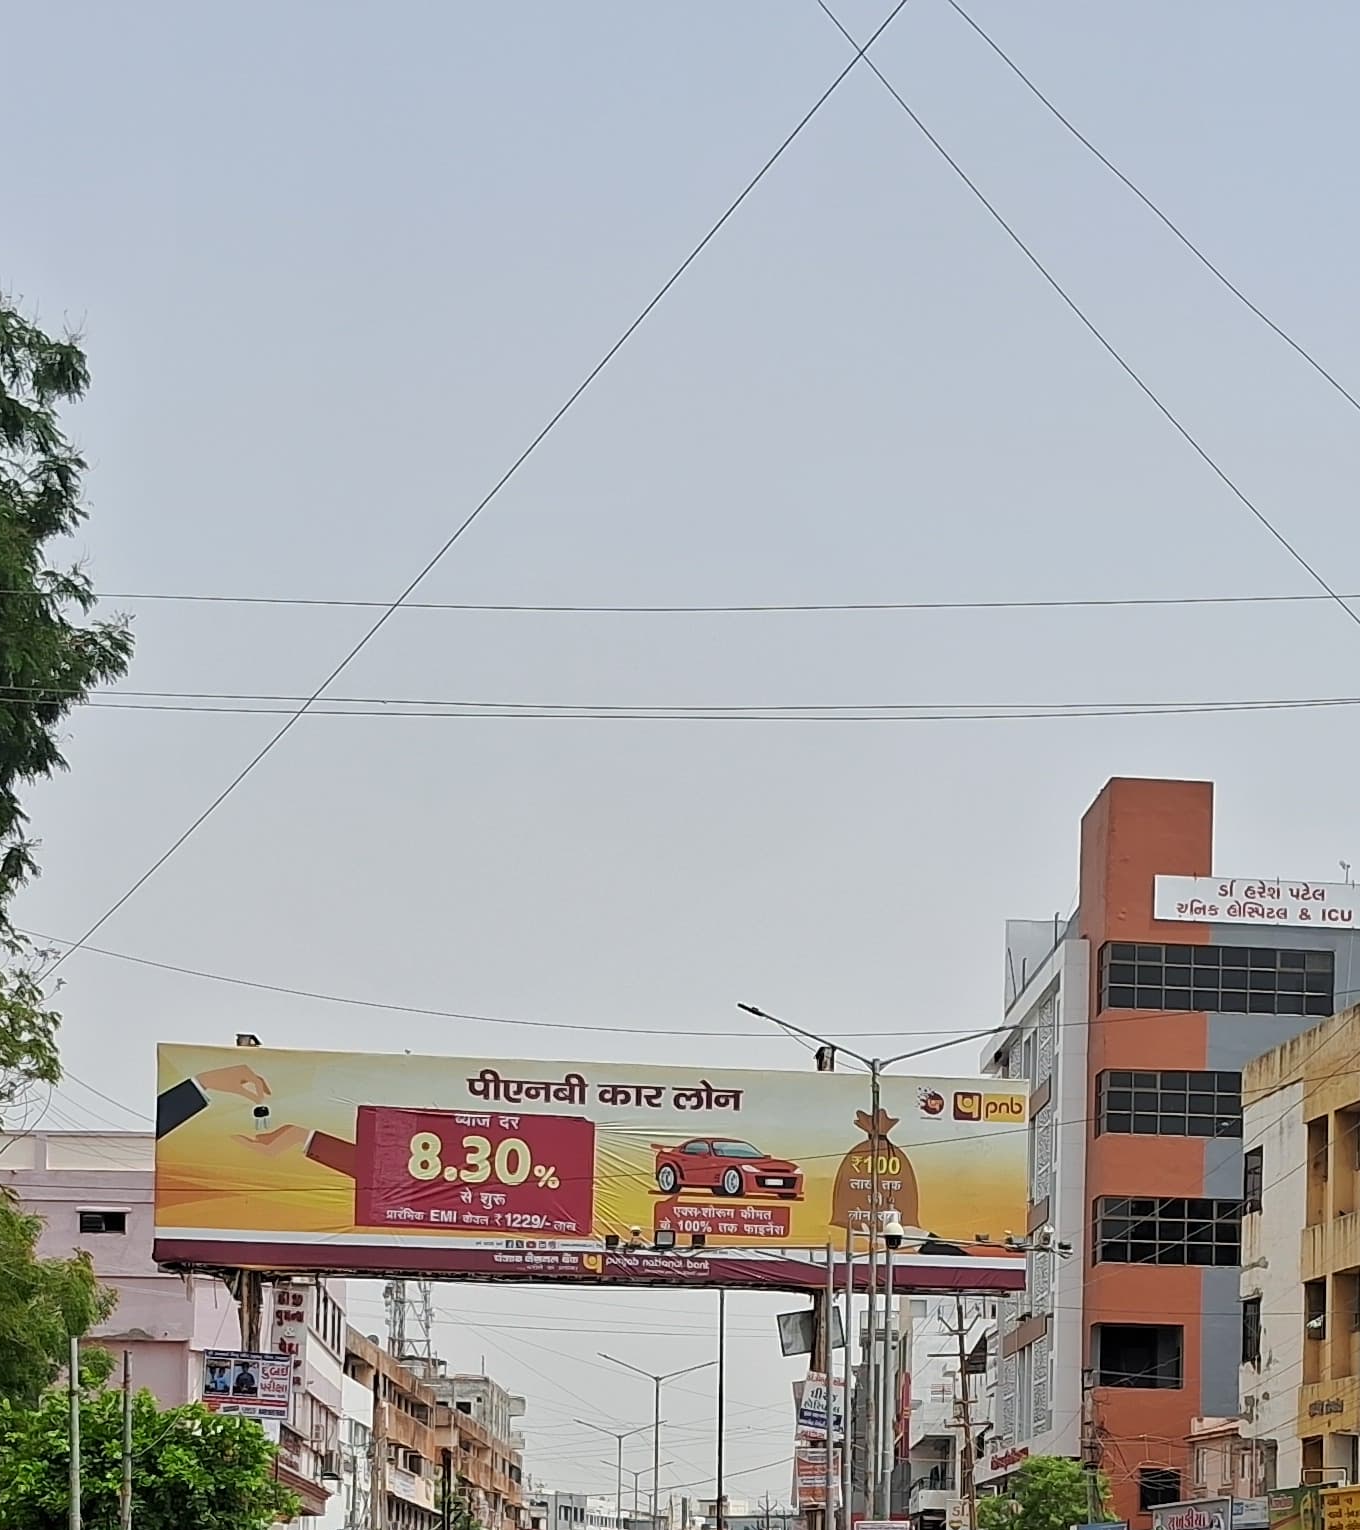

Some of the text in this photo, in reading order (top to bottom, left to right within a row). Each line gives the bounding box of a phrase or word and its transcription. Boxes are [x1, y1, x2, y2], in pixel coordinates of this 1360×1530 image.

[1244, 880, 1281, 899] હરેશ
[1289, 882, 1325, 901] પટેલ
[1227, 900, 1352, 922] હોસ્પિટલ & ICU
[466, 1068, 743, 1112] पीएनबी कार लोन
[985, 1096, 1023, 1119] pnb
[499, 1115, 520, 1131] दर
[407, 1131, 561, 1190] 8.30%
[460, 1187, 473, 1204] से
[429, 1209, 457, 1224] EMI
[740, 1206, 772, 1221] कीमत
[678, 1218, 712, 1233] 100%
[719, 1221, 737, 1235] तक
[606, 1254, 710, 1270] punjab national bank
